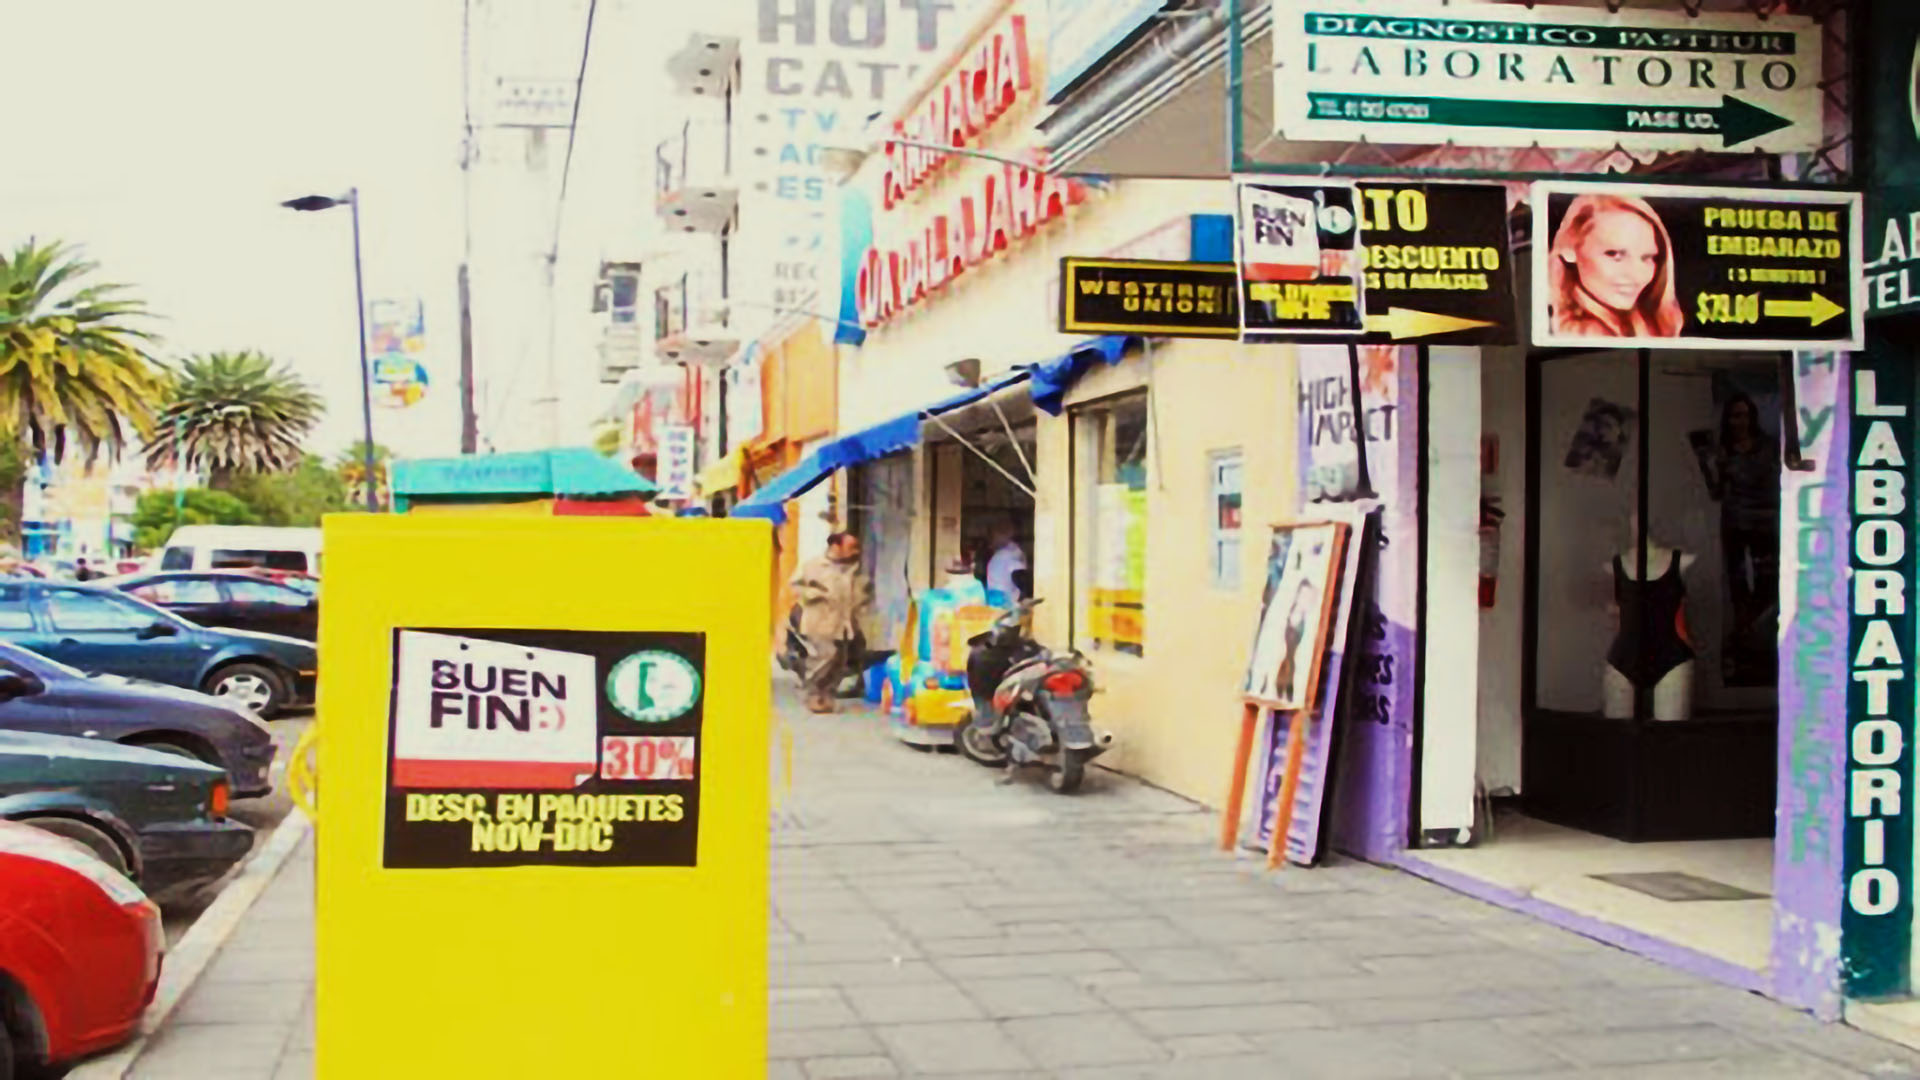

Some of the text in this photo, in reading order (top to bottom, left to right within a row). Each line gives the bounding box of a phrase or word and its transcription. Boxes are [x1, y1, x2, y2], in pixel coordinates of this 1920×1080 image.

[1315, 16, 1785, 50] DIAGNOSTICO PASTEUR
[766, 57, 920, 100] CAT
[1307, 42, 1797, 91] LABORATORIO
[1626, 110, 1680, 129] PASE
[1704, 207, 1839, 232] PRUEBA DE
[1707, 235, 1841, 259] EMBARAZO
[1079, 280, 1222, 299] WESTERN
[1123, 297, 1222, 314] UNION
[1848, 369, 1908, 916] LABORATORIO
[430, 659, 567, 701] BUEN
[603, 738, 695, 779] 30%
[405, 793, 684, 824] DESC. EN PAQUETES
[471, 821, 614, 853] NOV-DIC
